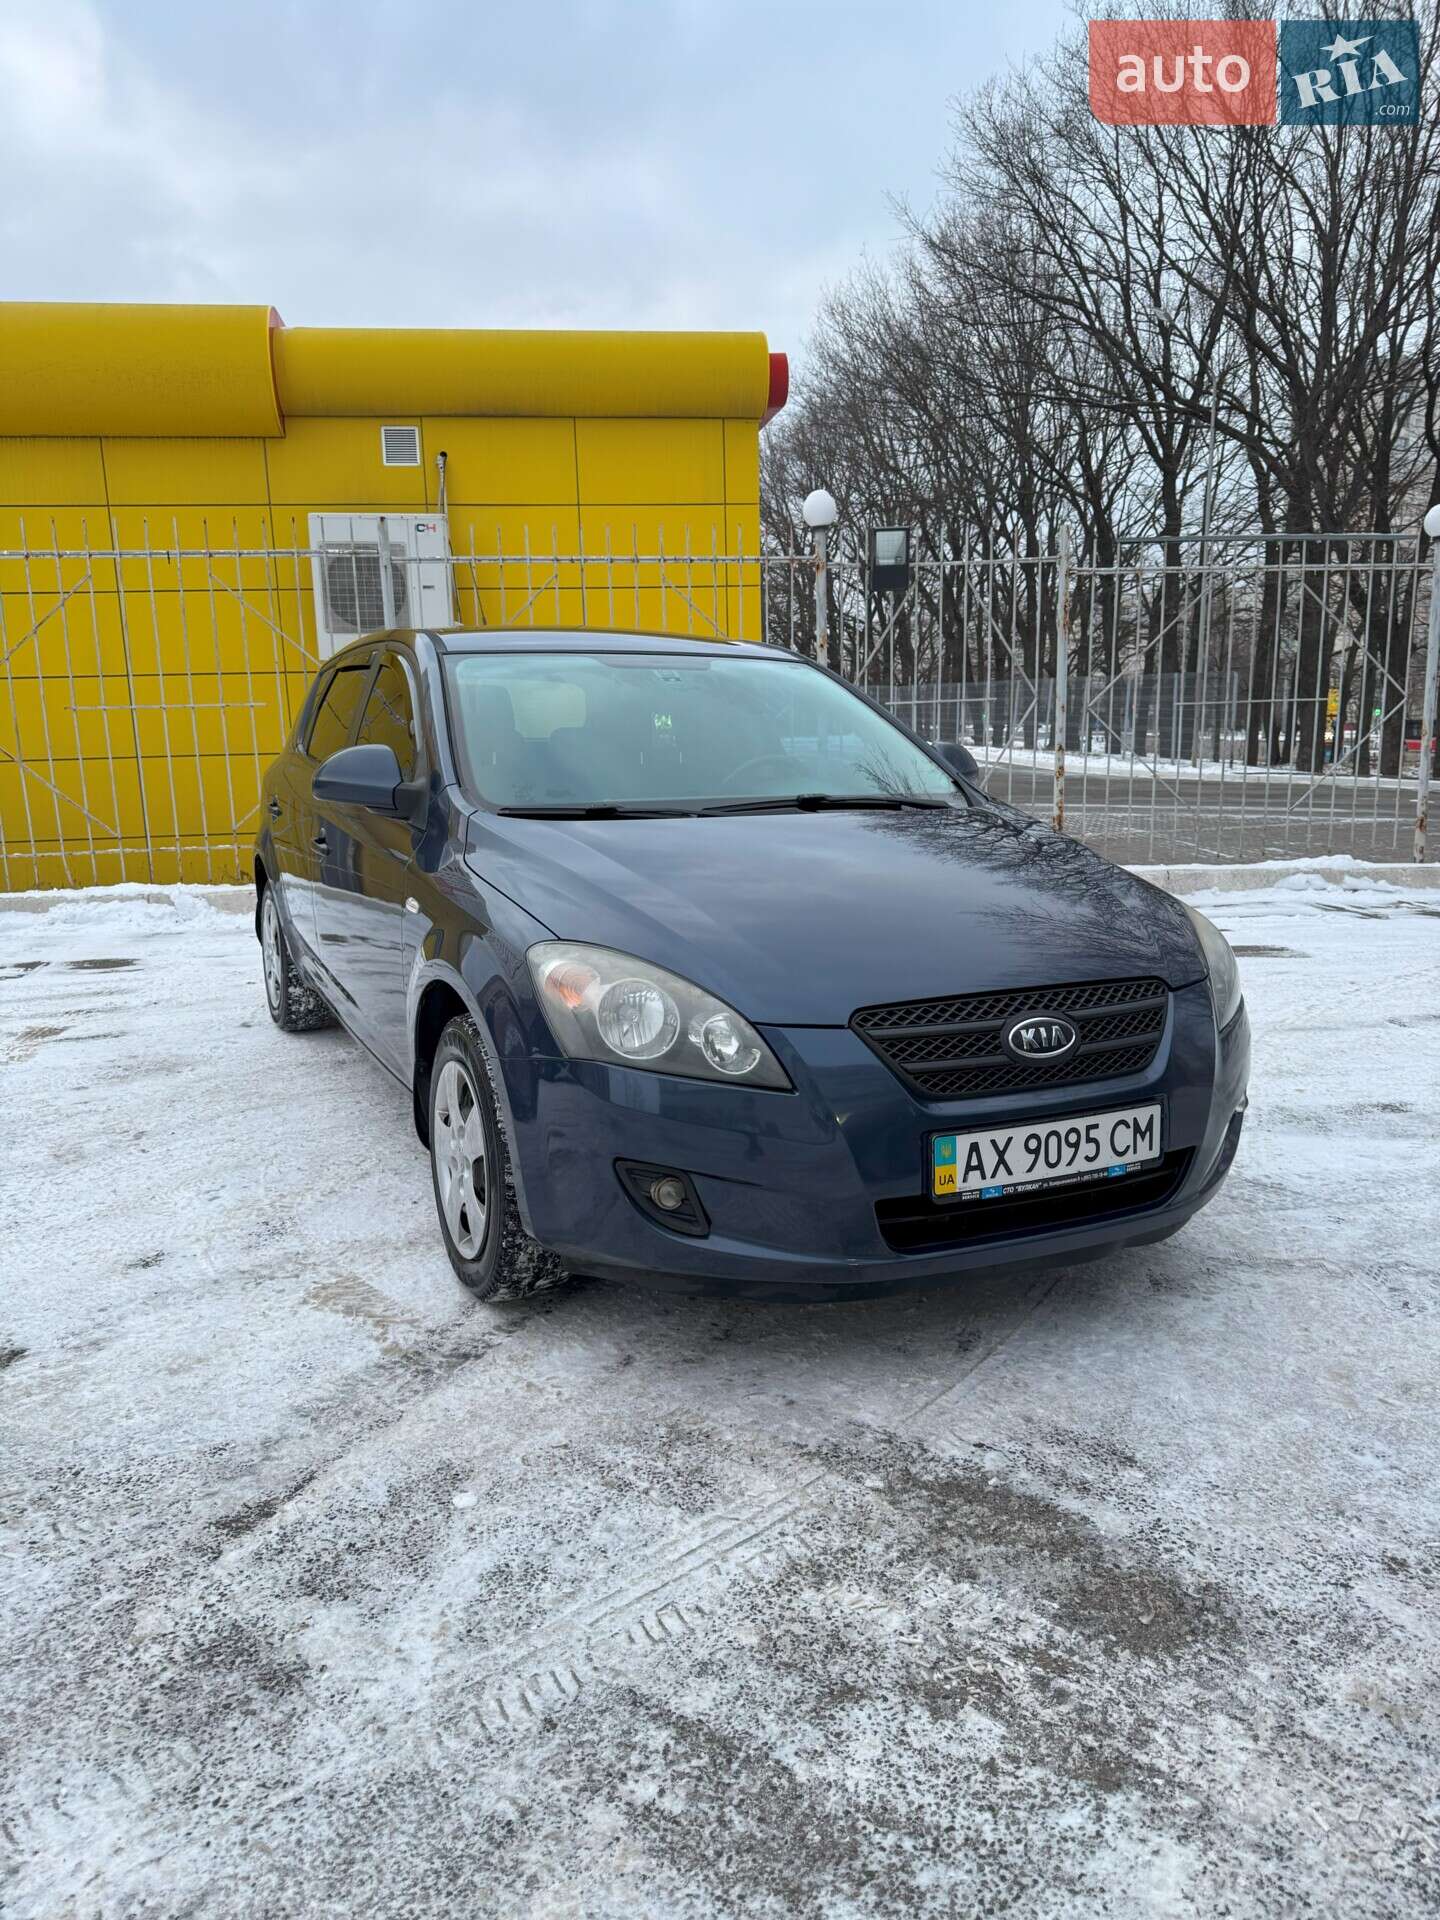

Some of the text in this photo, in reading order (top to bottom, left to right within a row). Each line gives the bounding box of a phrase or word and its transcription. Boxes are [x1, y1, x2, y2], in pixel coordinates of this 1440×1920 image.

[416, 523, 437, 533] CH
[1019, 1025, 1067, 1050] KIA
[962, 1136, 1014, 1184] AX
[1023, 1123, 1101, 1174] 9095
[1109, 1113, 1155, 1158] CM
[938, 1174, 955, 1187] UA
